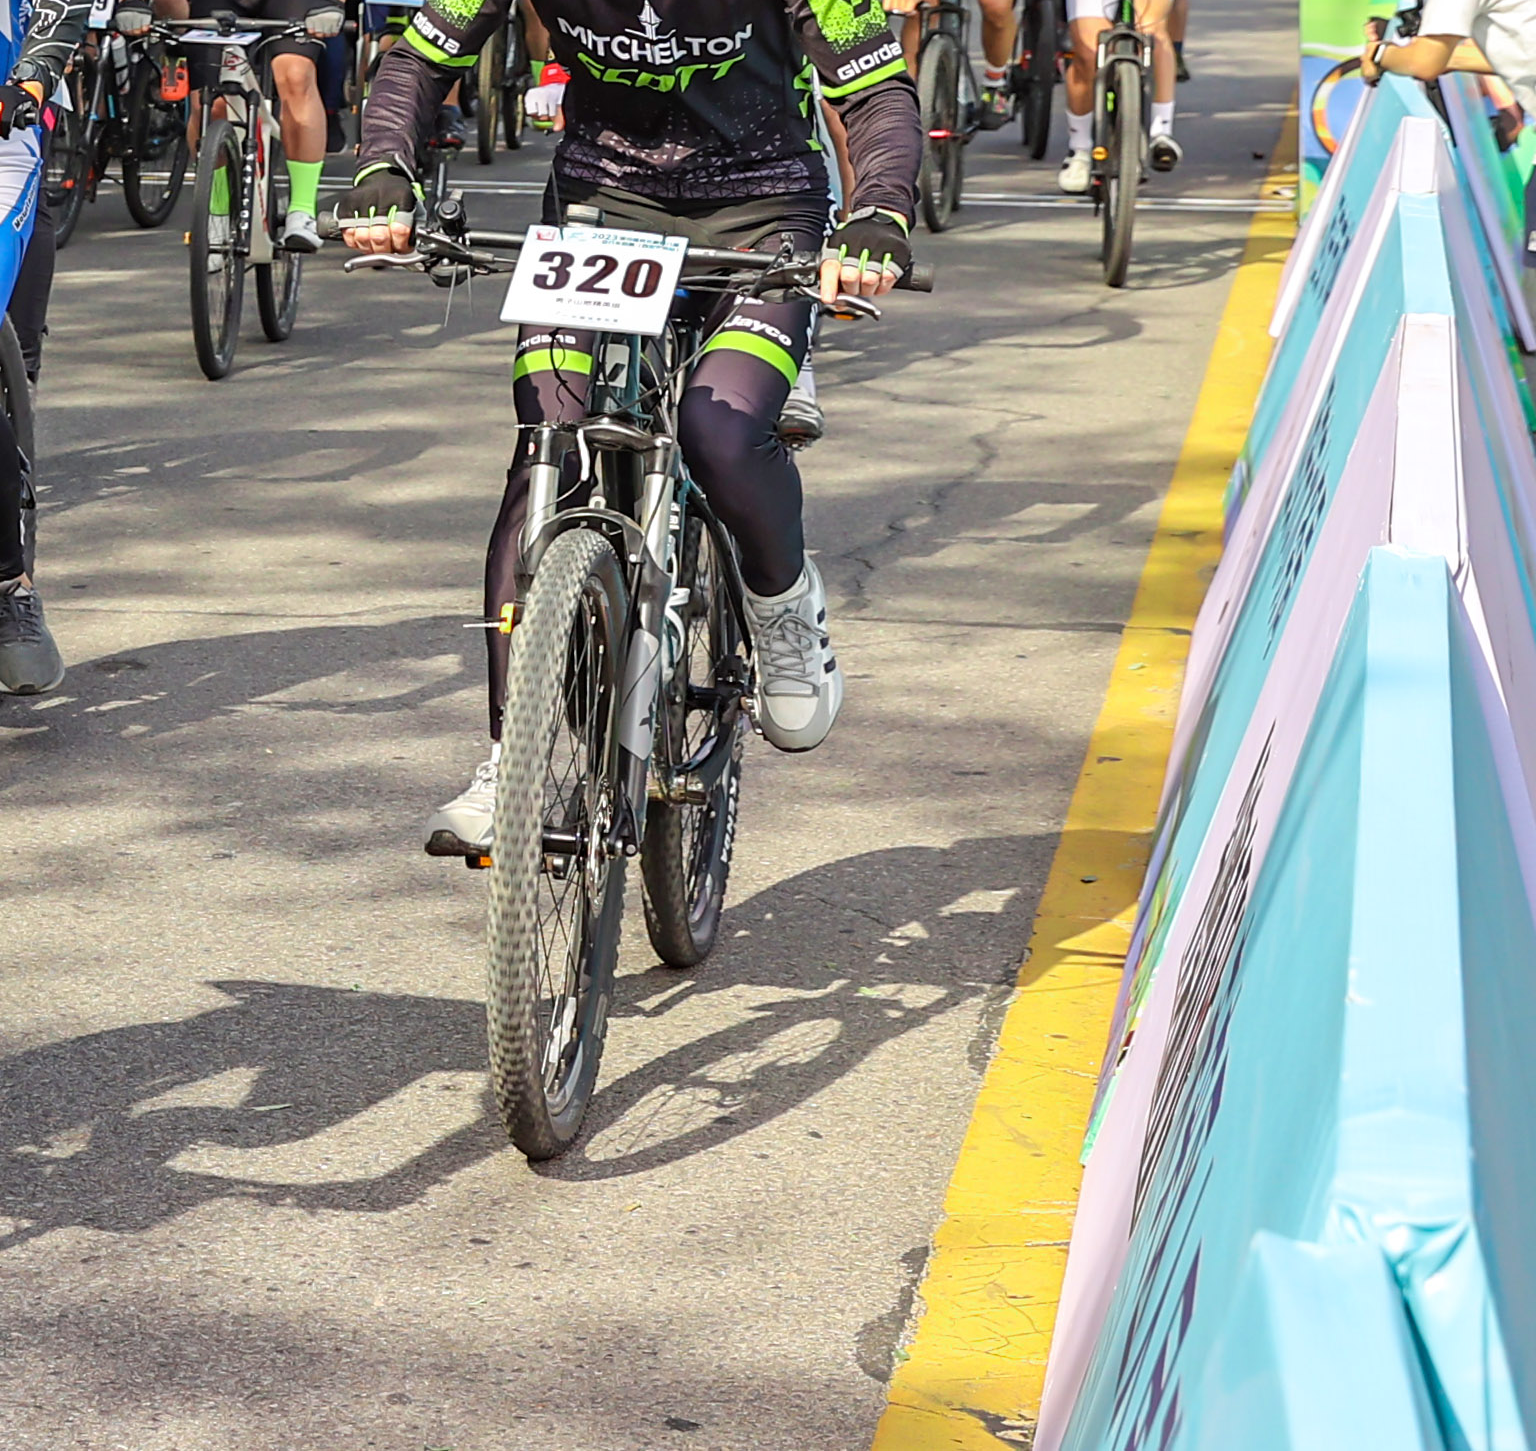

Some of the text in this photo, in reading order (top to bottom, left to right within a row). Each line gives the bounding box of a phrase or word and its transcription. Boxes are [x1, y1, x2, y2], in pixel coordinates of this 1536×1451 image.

[556, 16, 753, 66] MITCHELTON
[577, 52, 746, 93] SCOTT
[532, 251, 664, 299] 320
[724, 315, 793, 347] Jayco
